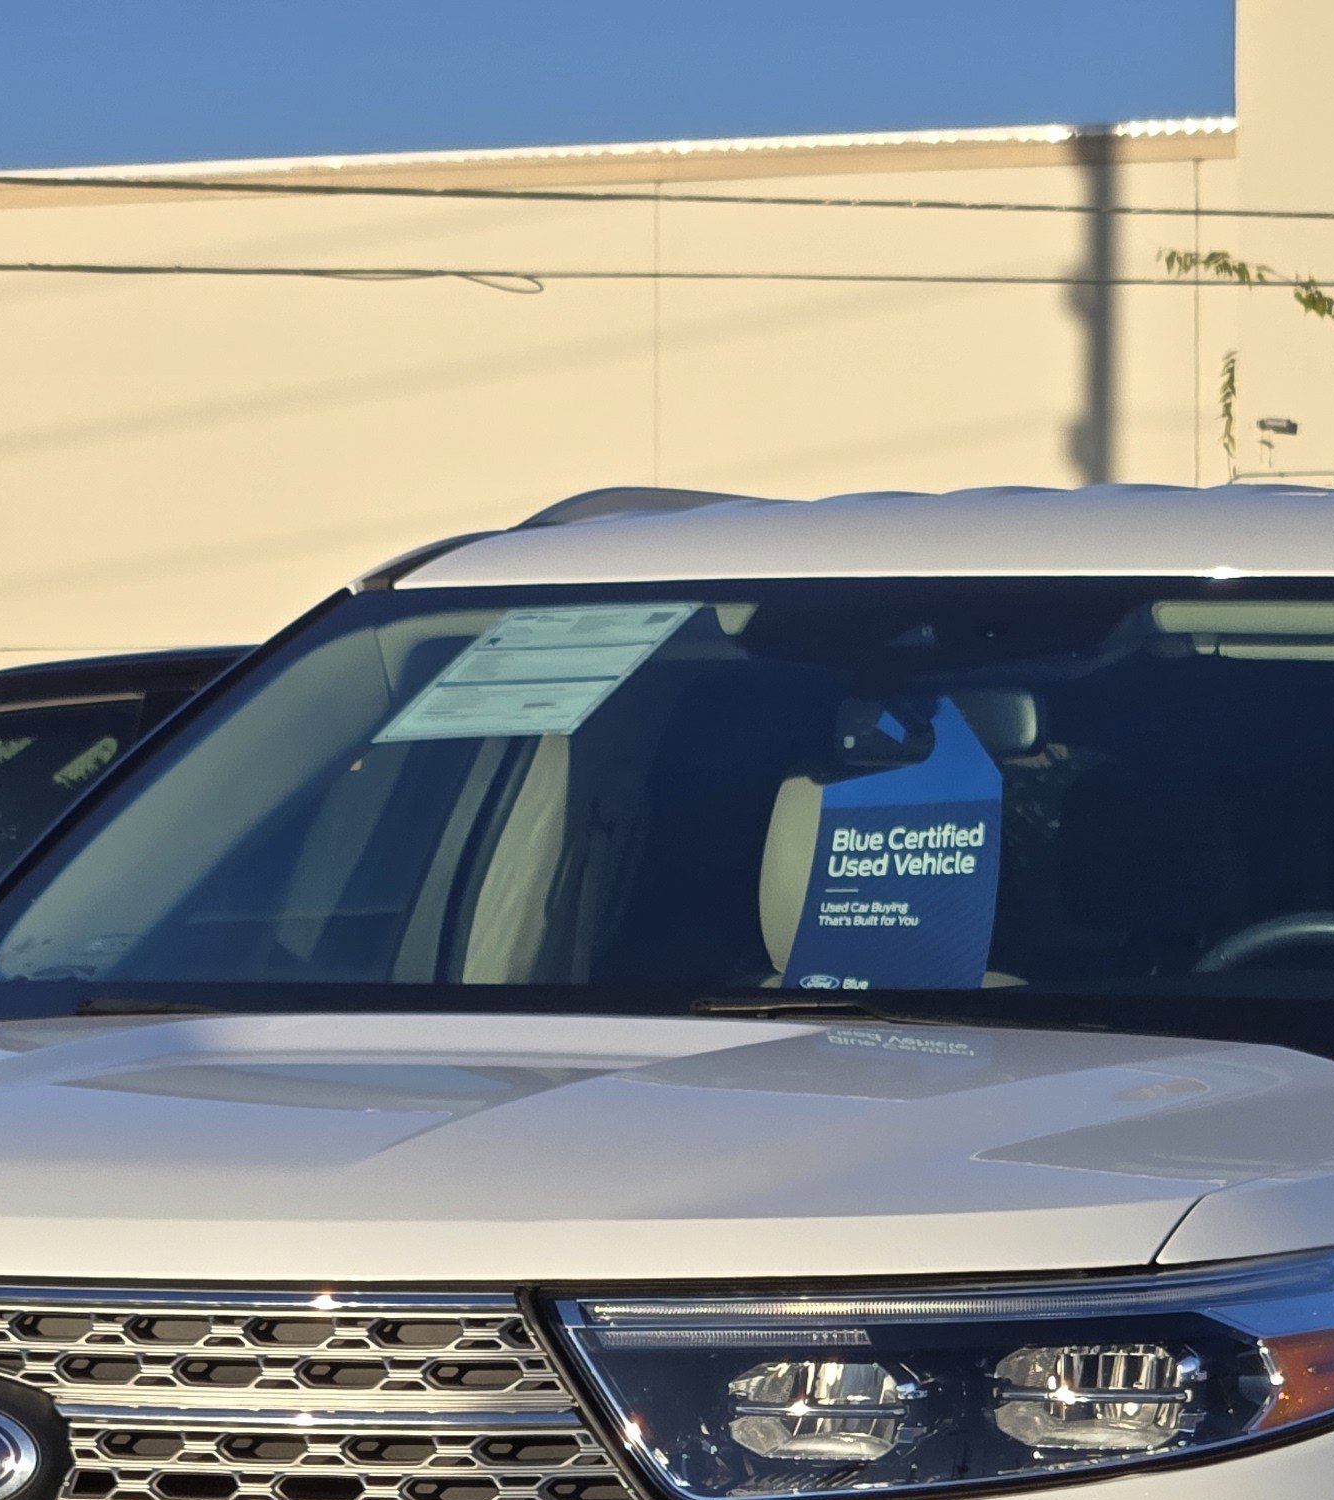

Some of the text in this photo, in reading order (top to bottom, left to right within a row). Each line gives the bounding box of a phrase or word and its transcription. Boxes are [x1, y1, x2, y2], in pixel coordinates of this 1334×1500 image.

[832, 821, 985, 852] Blue Certified
[828, 850, 977, 877] Used Vehicle
[820, 901, 908, 915] Used Car Buying
[819, 915, 919, 926] That's Built for You
[842, 977, 869, 989] Blue
